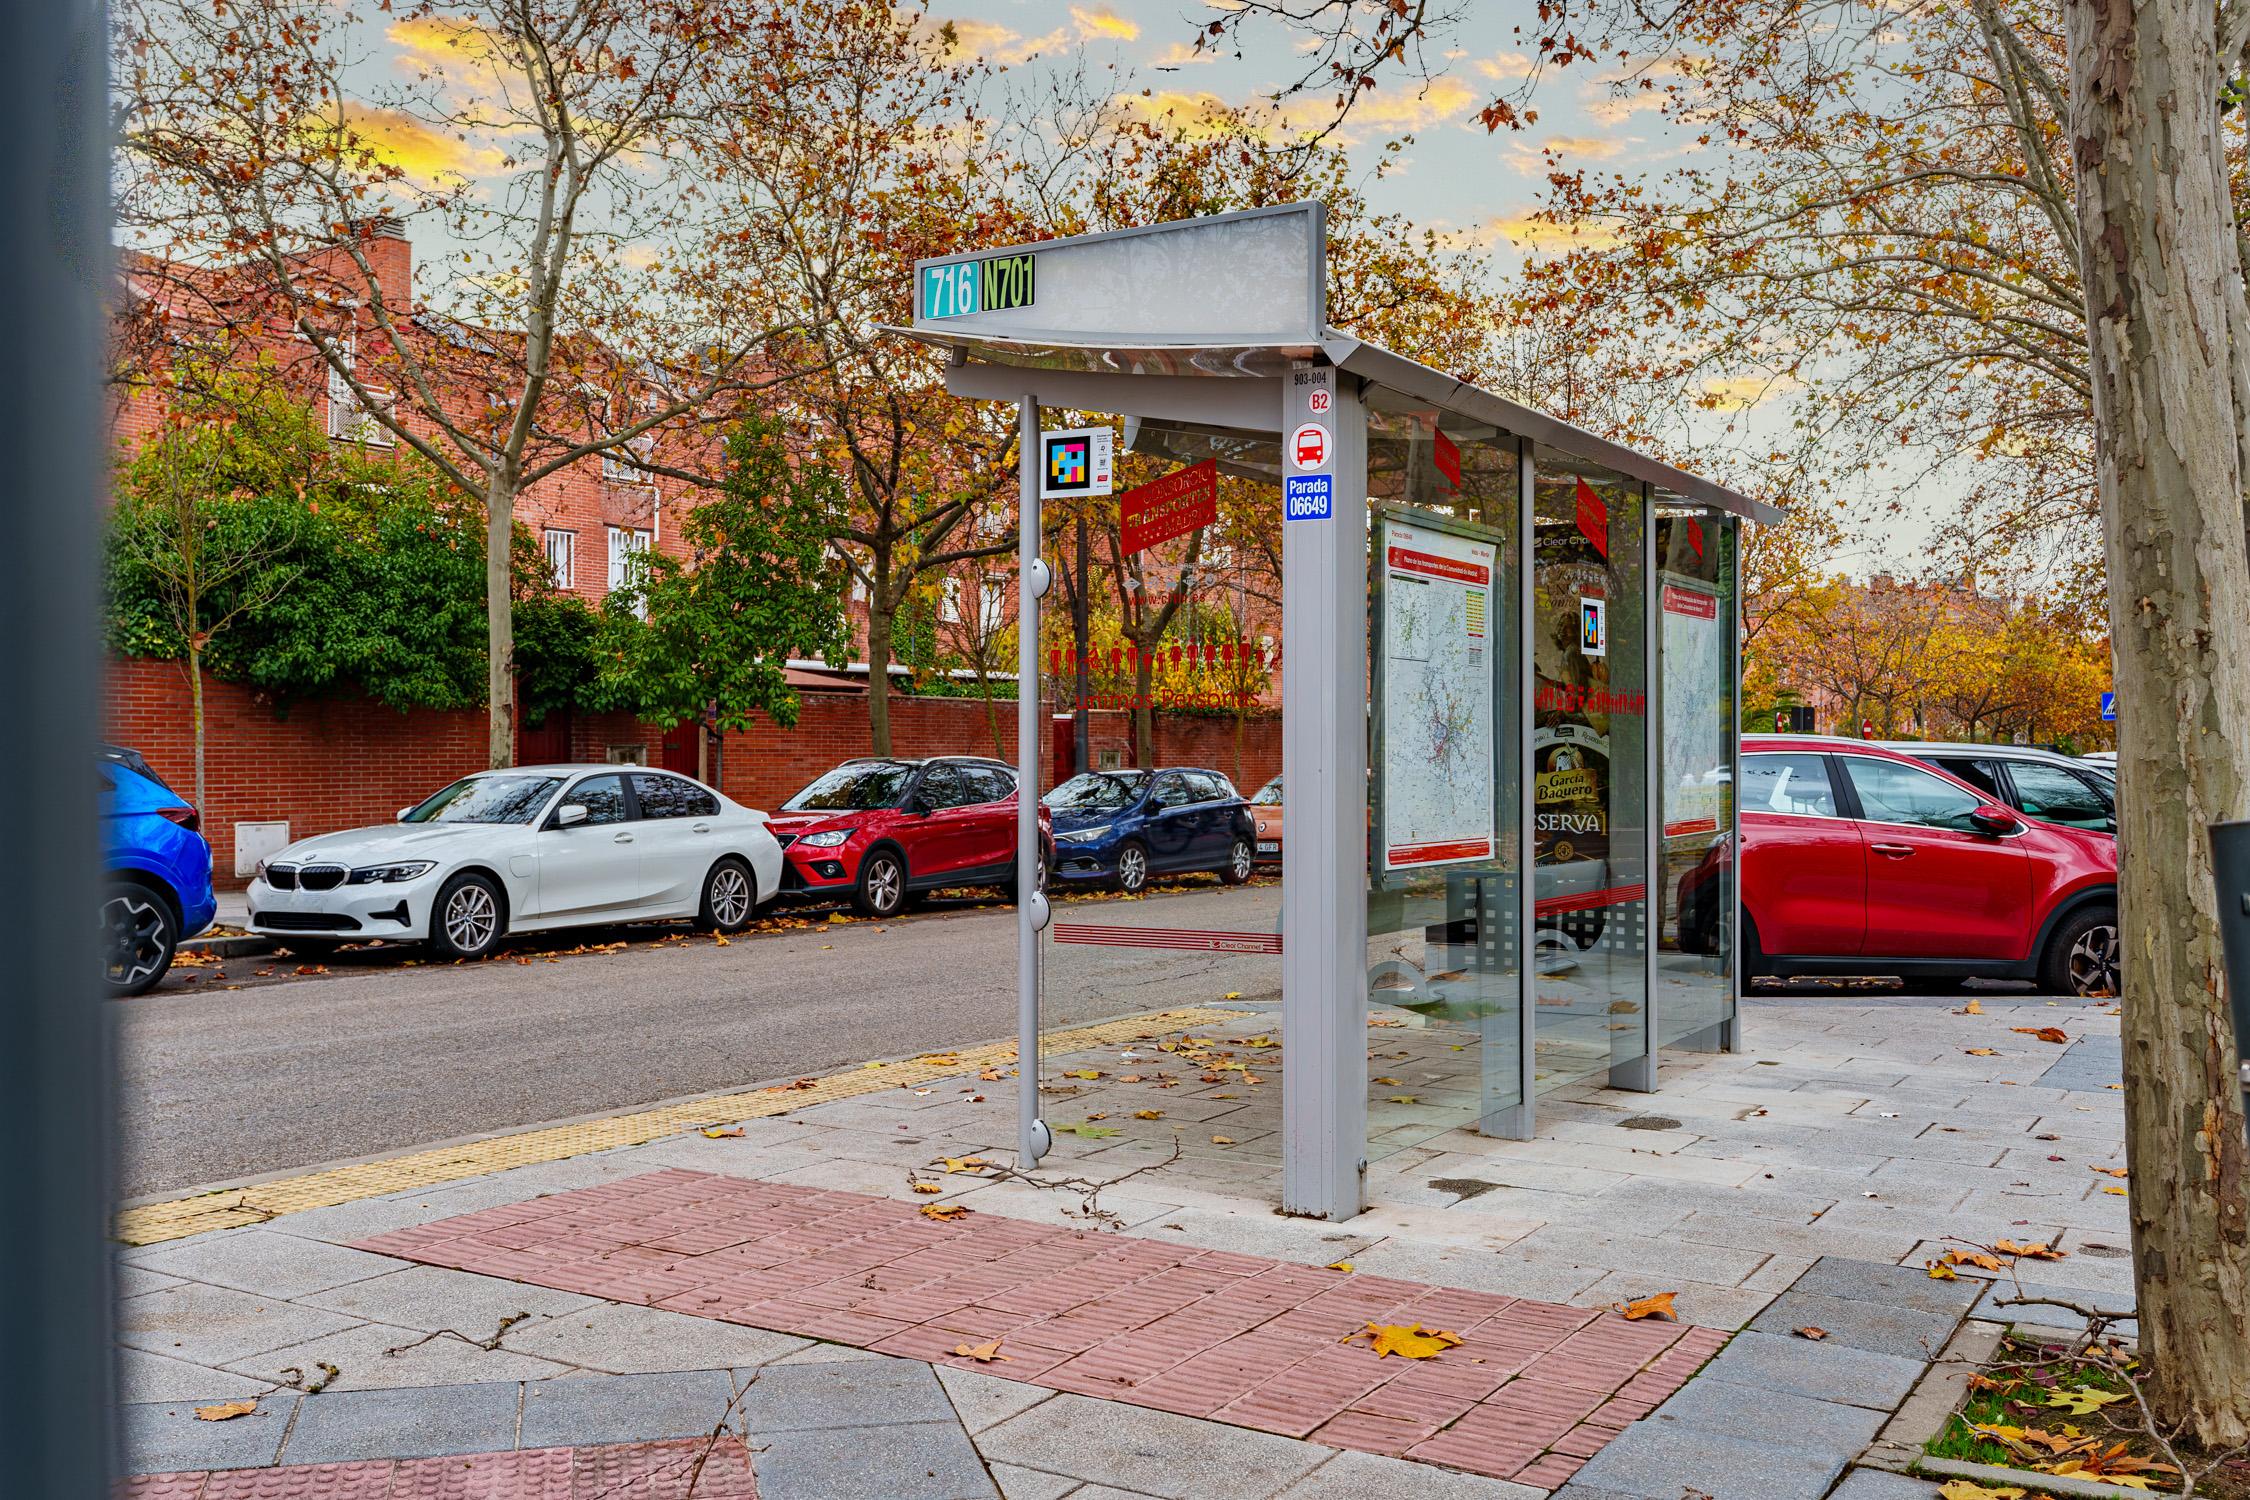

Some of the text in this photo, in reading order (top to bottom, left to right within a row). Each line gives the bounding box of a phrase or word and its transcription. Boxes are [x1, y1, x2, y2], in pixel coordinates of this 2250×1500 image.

[931, 264, 972, 317] 716
[983, 255, 1033, 311] N701
[1294, 372, 1326, 386] 903-004
[1312, 394, 1328, 410] B2
[1143, 467, 1211, 504] CONSORCIO
[1289, 479, 1328, 495] Parada
[1127, 485, 1211, 528] TRANSPORTES
[1290, 495, 1328, 517] 06649
[1543, 537, 1568, 546] Clear
[1075, 688, 1260, 710] unimos Personas
[1549, 773, 1584, 787] García
[1538, 784, 1592, 799] Baquero
[1533, 813, 1600, 834] SERVA
[1264, 843, 1278, 851] GFR
[1221, 941, 1261, 950] Clear Channel
